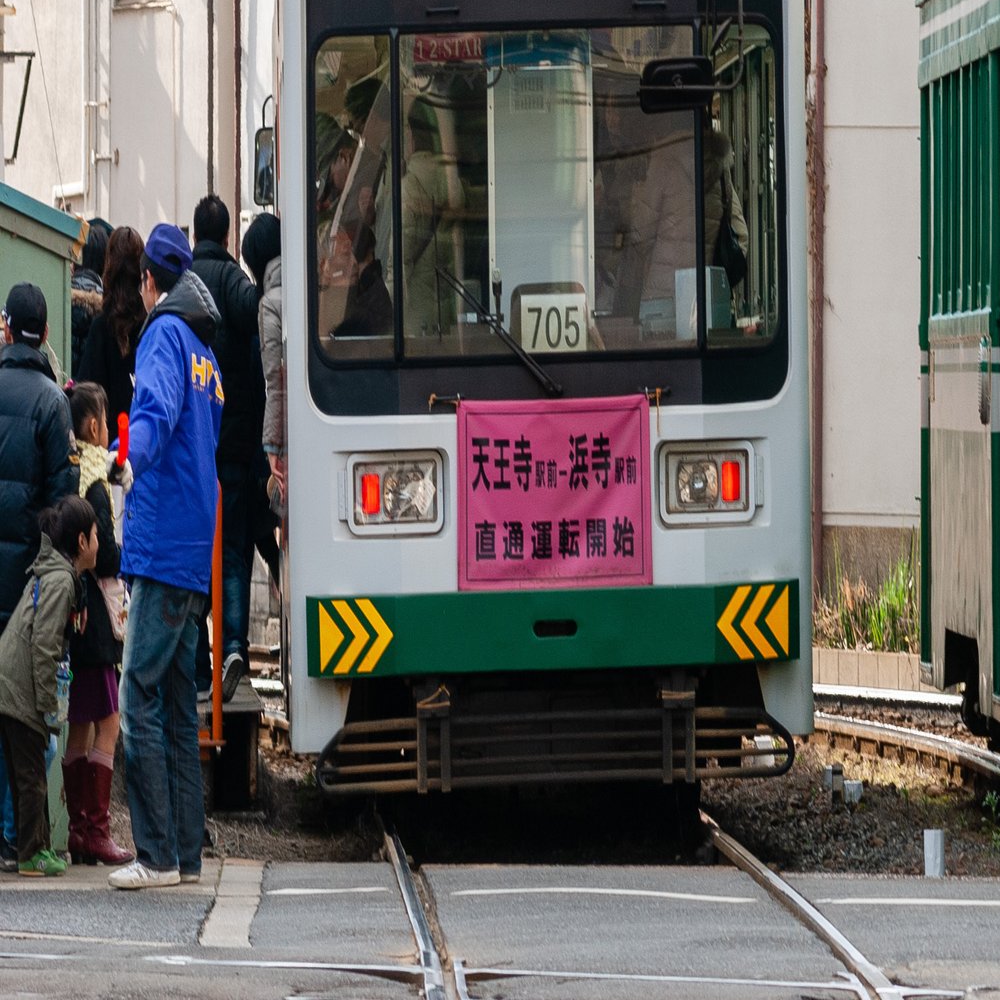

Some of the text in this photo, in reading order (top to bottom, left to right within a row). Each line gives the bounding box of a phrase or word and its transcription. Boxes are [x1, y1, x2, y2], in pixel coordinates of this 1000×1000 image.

[527, 305, 580, 349] 705
[475, 516, 635, 561] 直通運転開始
